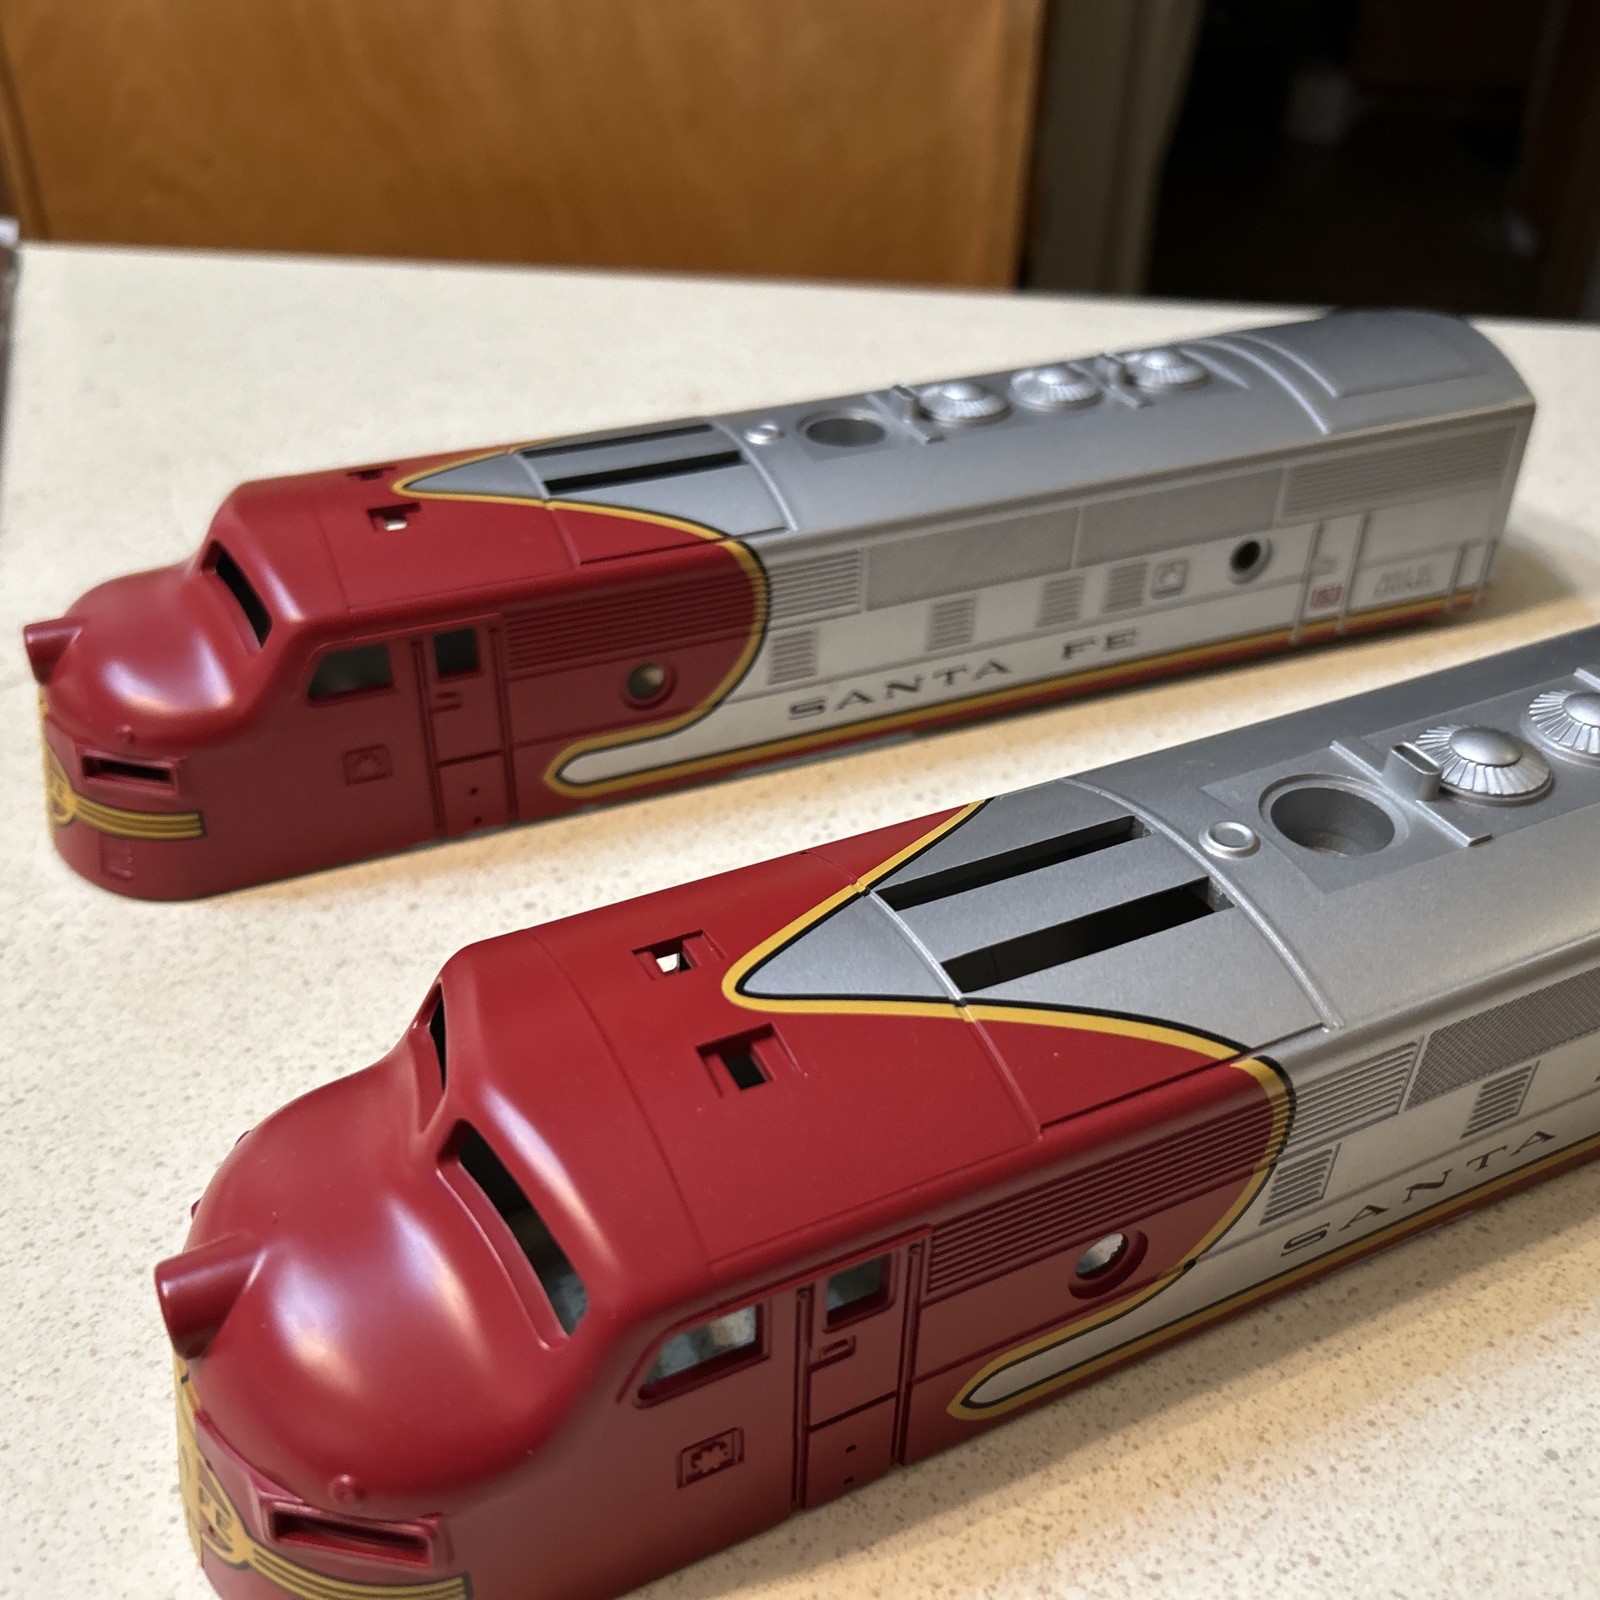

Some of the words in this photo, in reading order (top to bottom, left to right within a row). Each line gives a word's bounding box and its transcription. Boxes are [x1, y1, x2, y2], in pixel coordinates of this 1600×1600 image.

[789, 659, 1013, 721] SANTA
[1062, 628, 1139, 661] FE
[1280, 1130, 1556, 1257] SANTA
